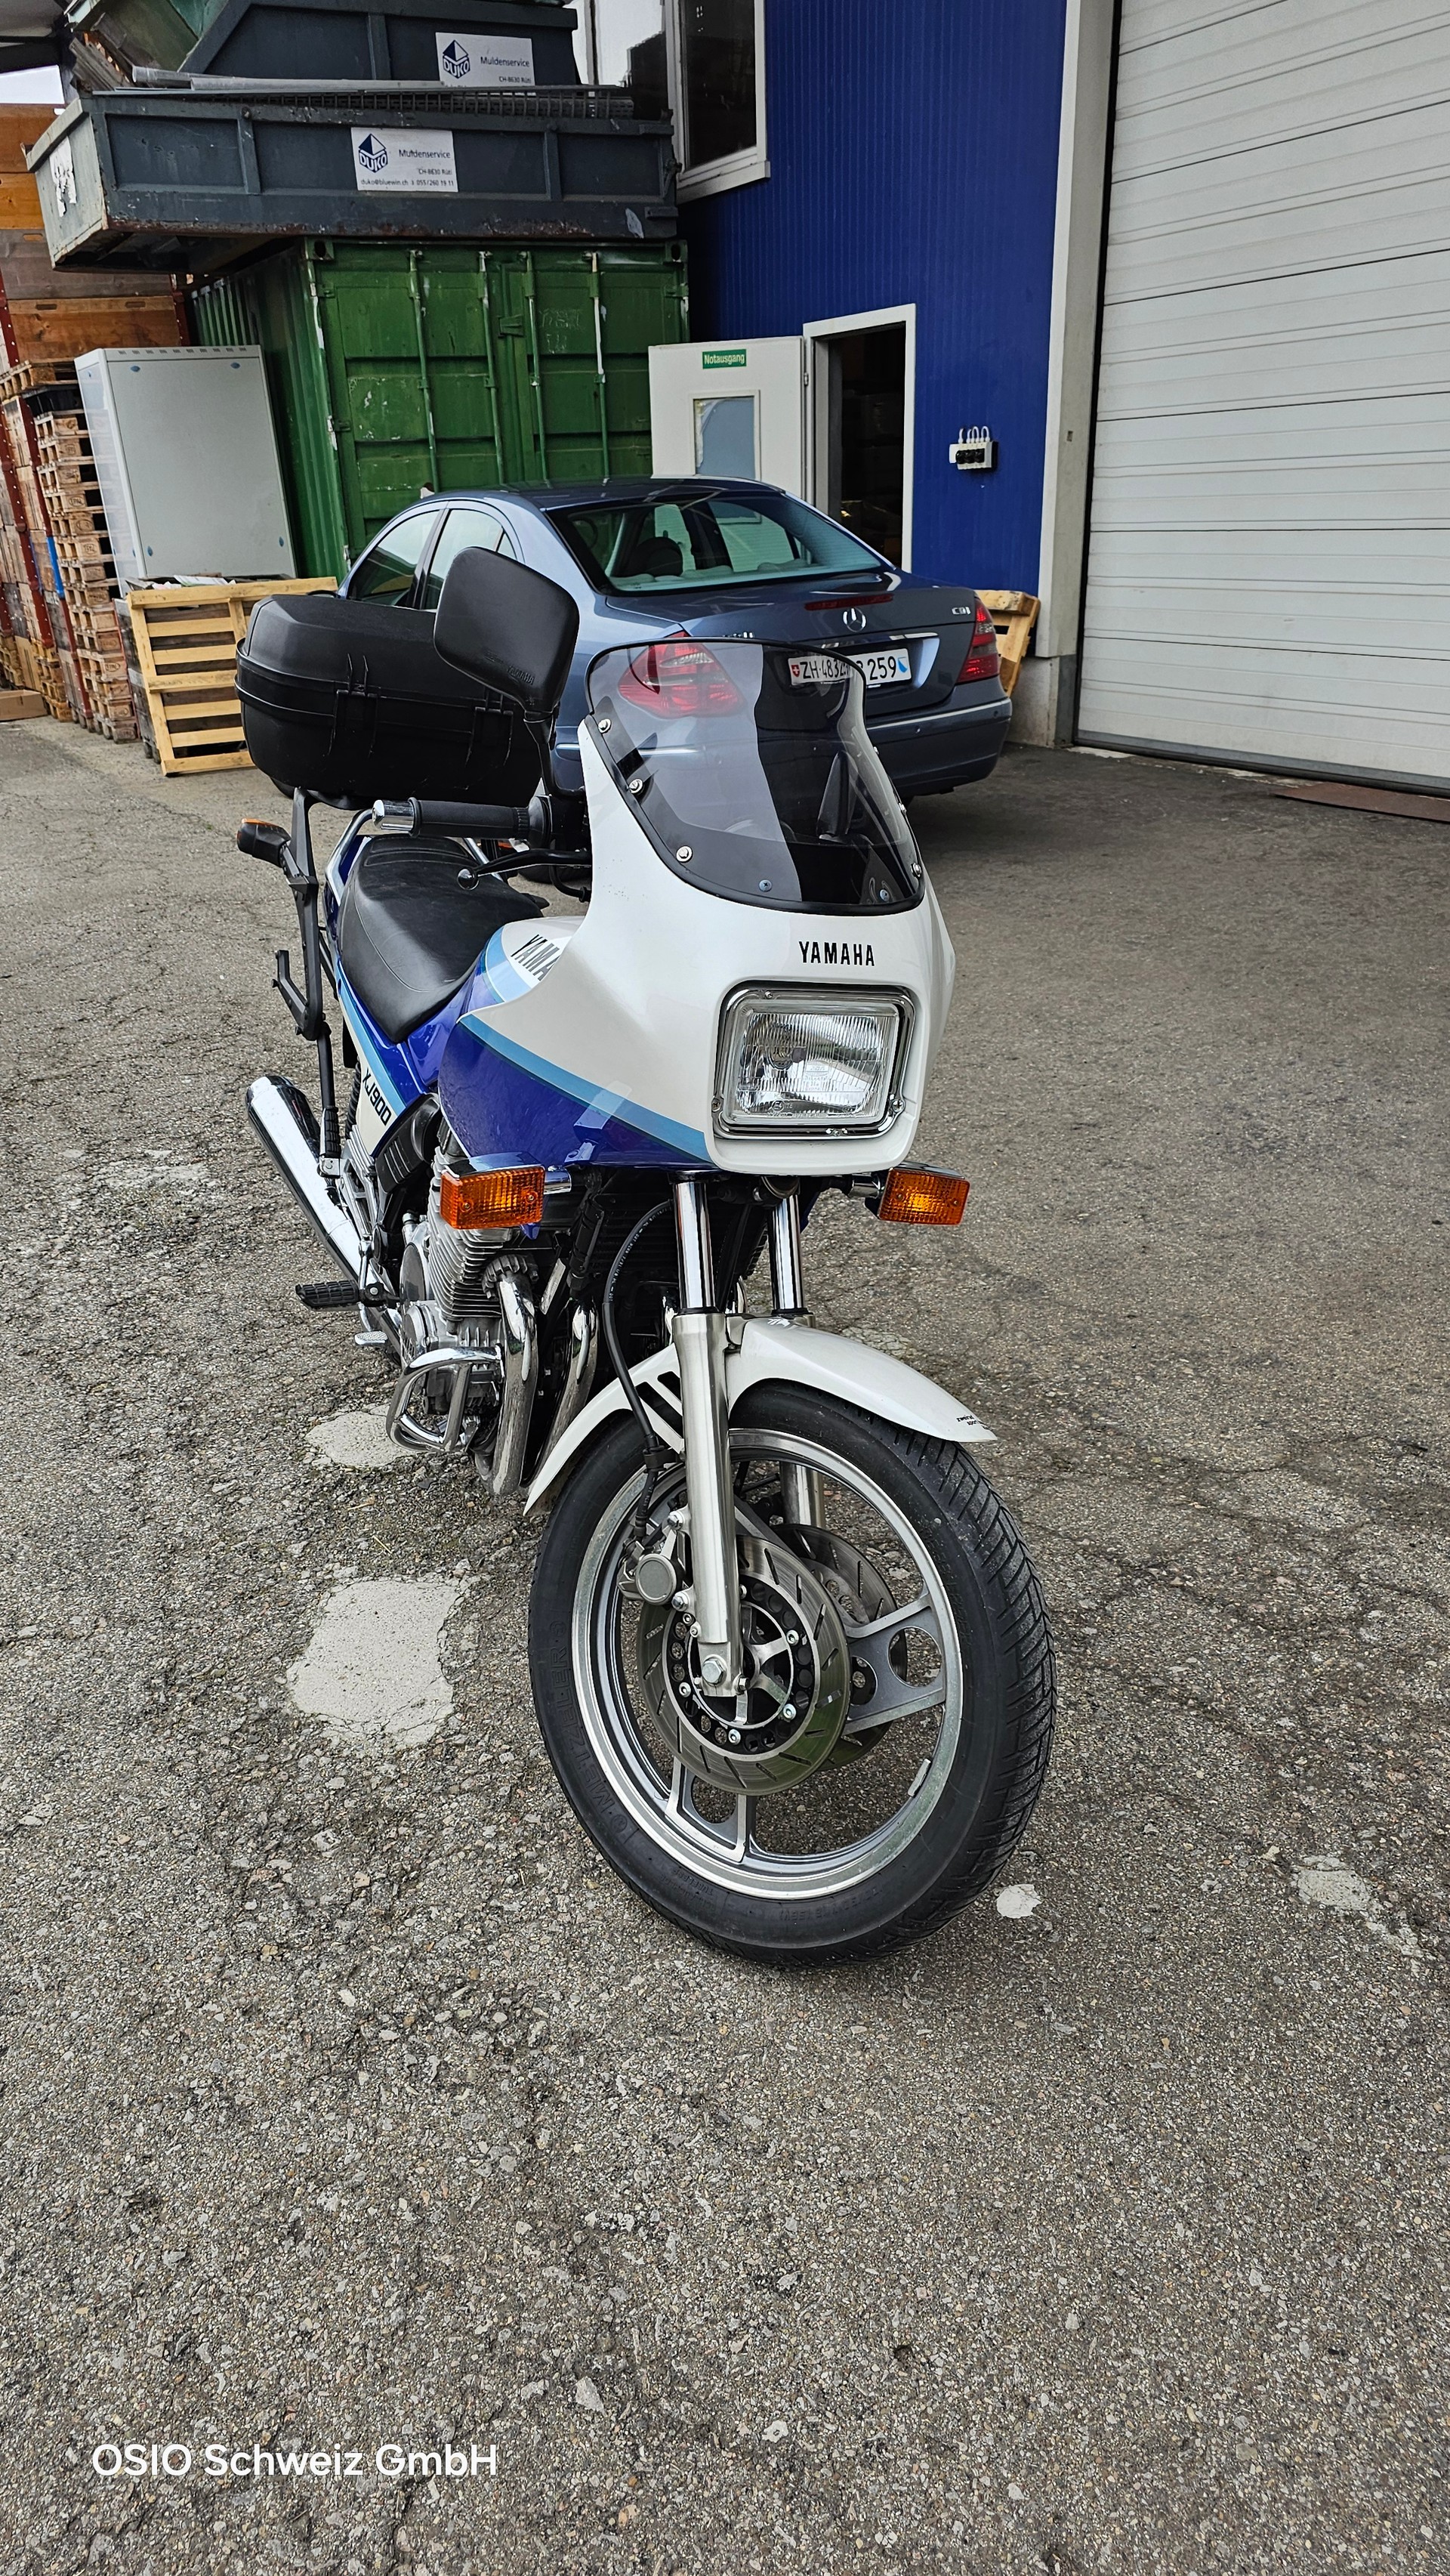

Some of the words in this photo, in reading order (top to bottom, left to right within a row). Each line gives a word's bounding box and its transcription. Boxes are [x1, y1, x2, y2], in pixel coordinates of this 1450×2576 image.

[443, 58, 470, 77] DUKO
[480, 56, 529, 67] Muldenservice
[359, 153, 387, 171] DUKO
[399, 149, 451, 159] Muldenservice
[704, 354, 745, 366] Notausgang
[952, 607, 971, 615] CDI
[798, 941, 875, 967] YAMAHA
[362, 1067, 393, 1126] XJ900
[550, 1645, 616, 1809] METZELER
